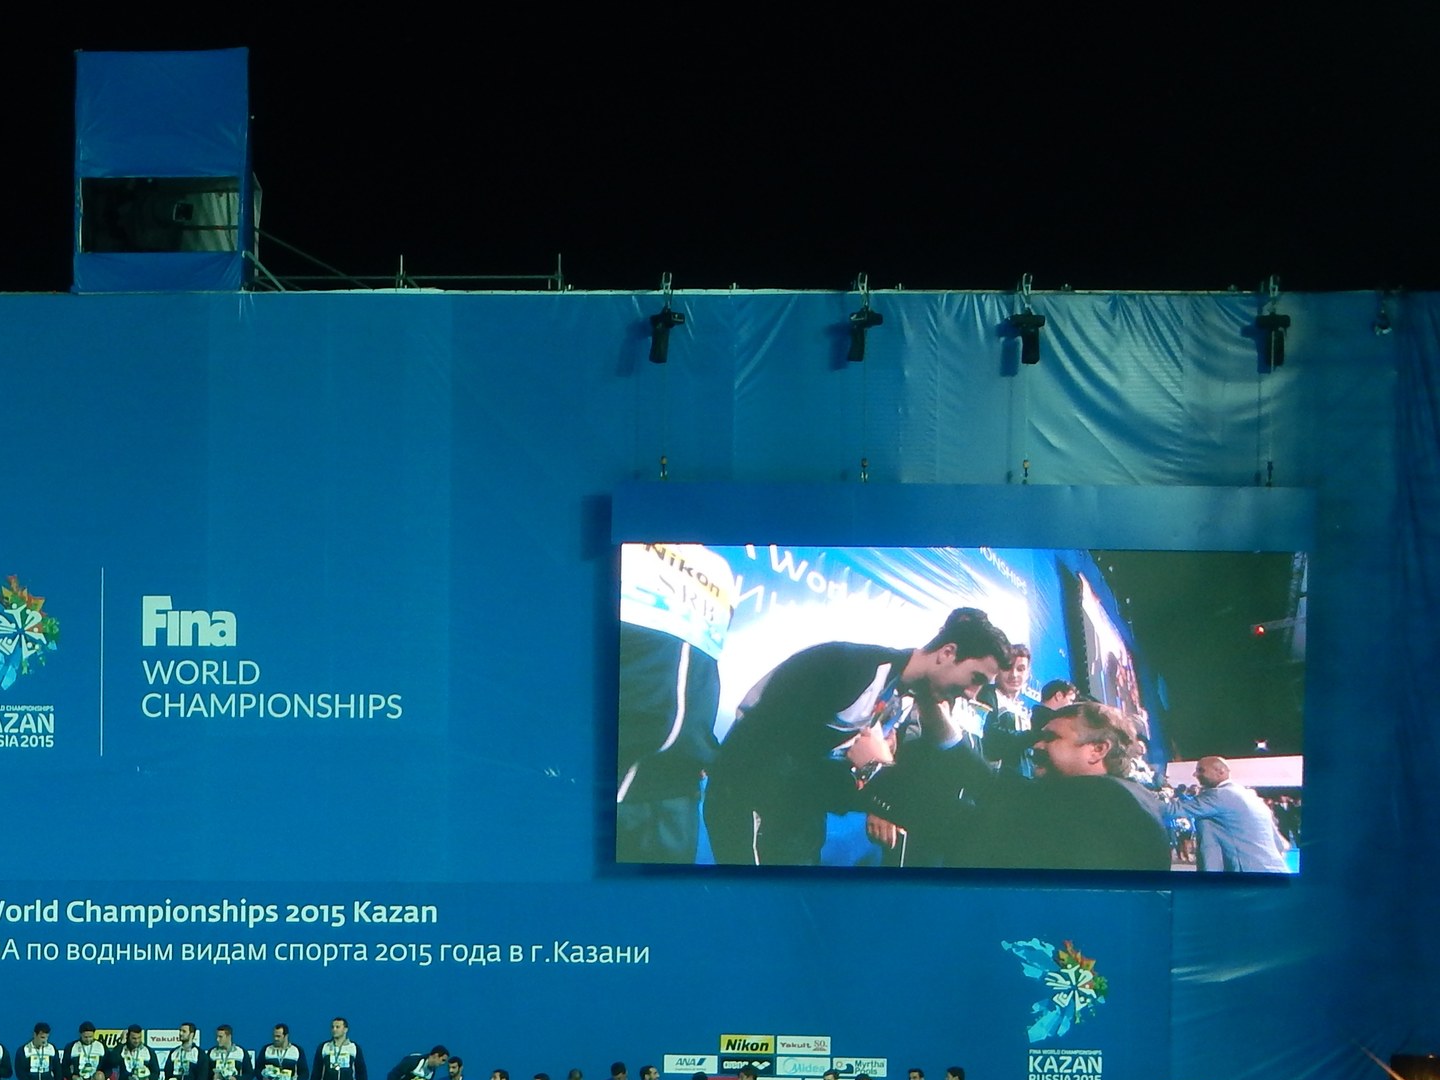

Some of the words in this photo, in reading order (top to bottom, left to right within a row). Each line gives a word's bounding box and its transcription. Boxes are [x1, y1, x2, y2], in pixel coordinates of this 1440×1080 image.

[644, 543, 720, 597] Nikon
[142, 595, 237, 647] Fina
[142, 660, 260, 685] WORLD
[6, 704, 54, 712] CHAMPIONSHIPS
[141, 693, 403, 719] CHAMPIONSHIPS
[20, 734, 54, 748] 2015
[67, 898, 278, 928] Championships
[286, 904, 346, 928] 2015
[353, 900, 438, 924] Kazan
[27, 943, 59, 961] по
[67, 943, 173, 966] водным
[182, 942, 267, 964] видам
[275, 943, 368, 966] спорта
[375, 943, 433, 966] 2015
[440, 943, 501, 966] года
[509, 944, 523, 962] в
[725, 1039, 769, 1052] Nikon
[676, 1058, 699, 1066] ANA
[793, 1063, 825, 1073] Midea
[854, 1060, 885, 1069] Myrtha
[1028, 1055, 1103, 1073] KAZAN
